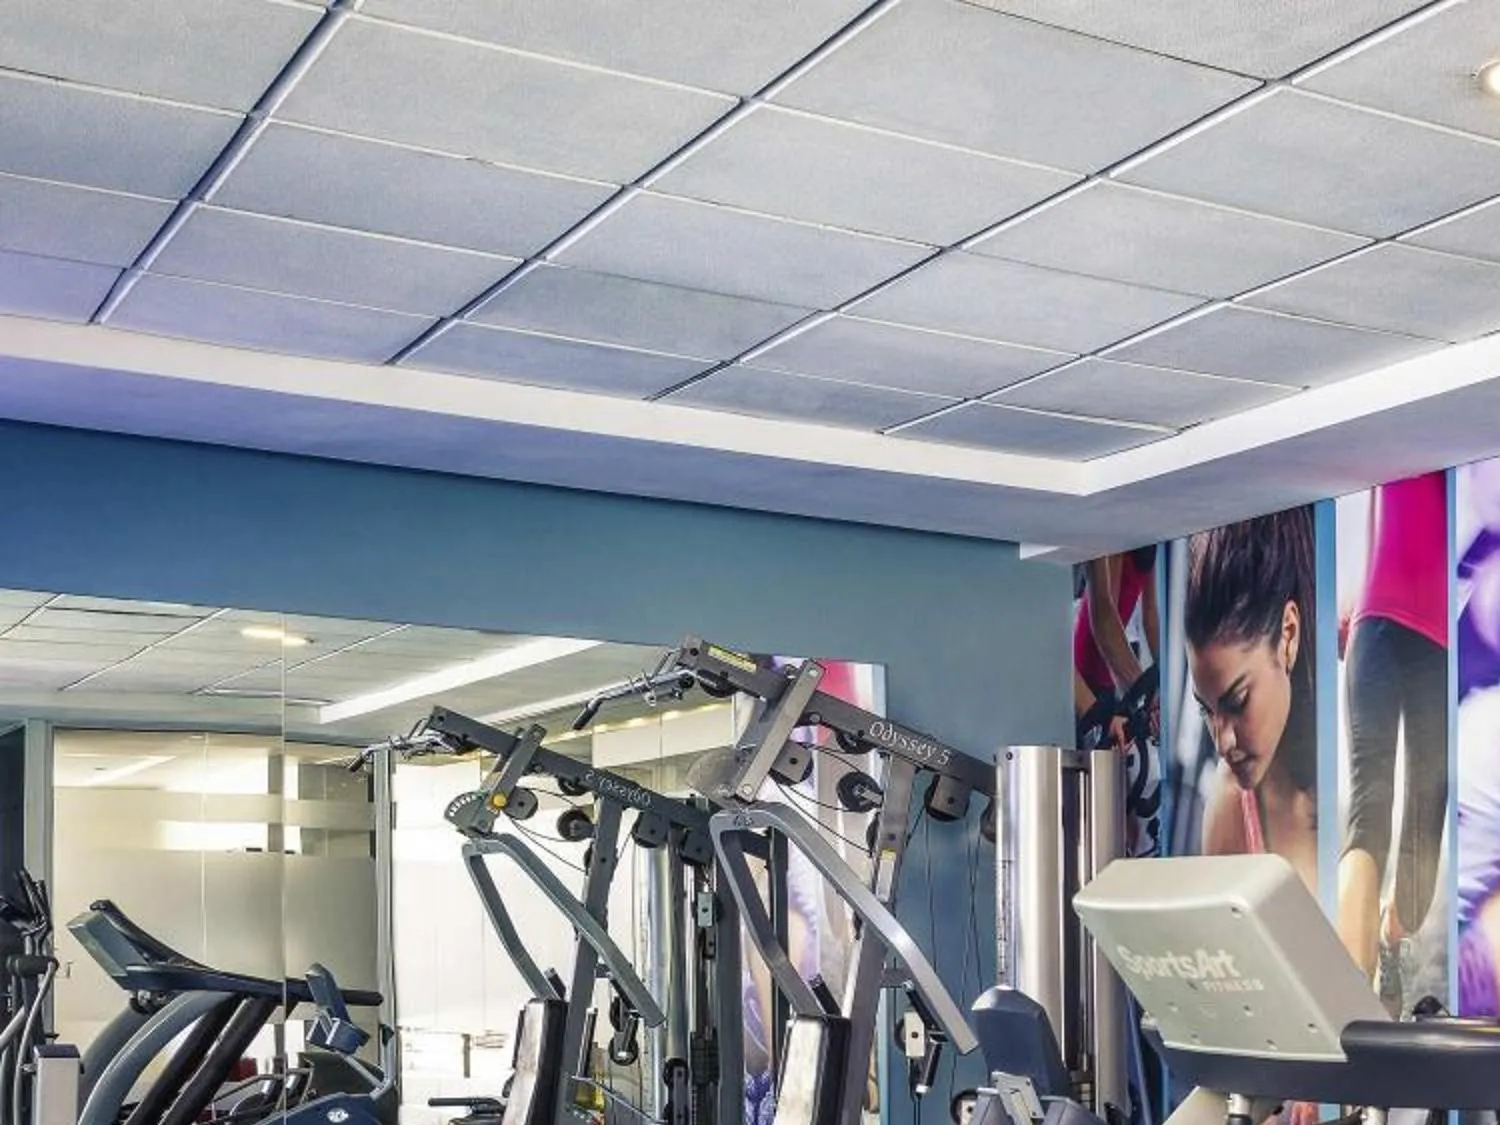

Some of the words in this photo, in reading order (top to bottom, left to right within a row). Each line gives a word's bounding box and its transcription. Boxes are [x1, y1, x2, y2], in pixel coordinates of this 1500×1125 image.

[869, 721, 937, 760] Odyssey
[937, 749, 952, 766] 5
[1116, 944, 1241, 981] SportsArt
